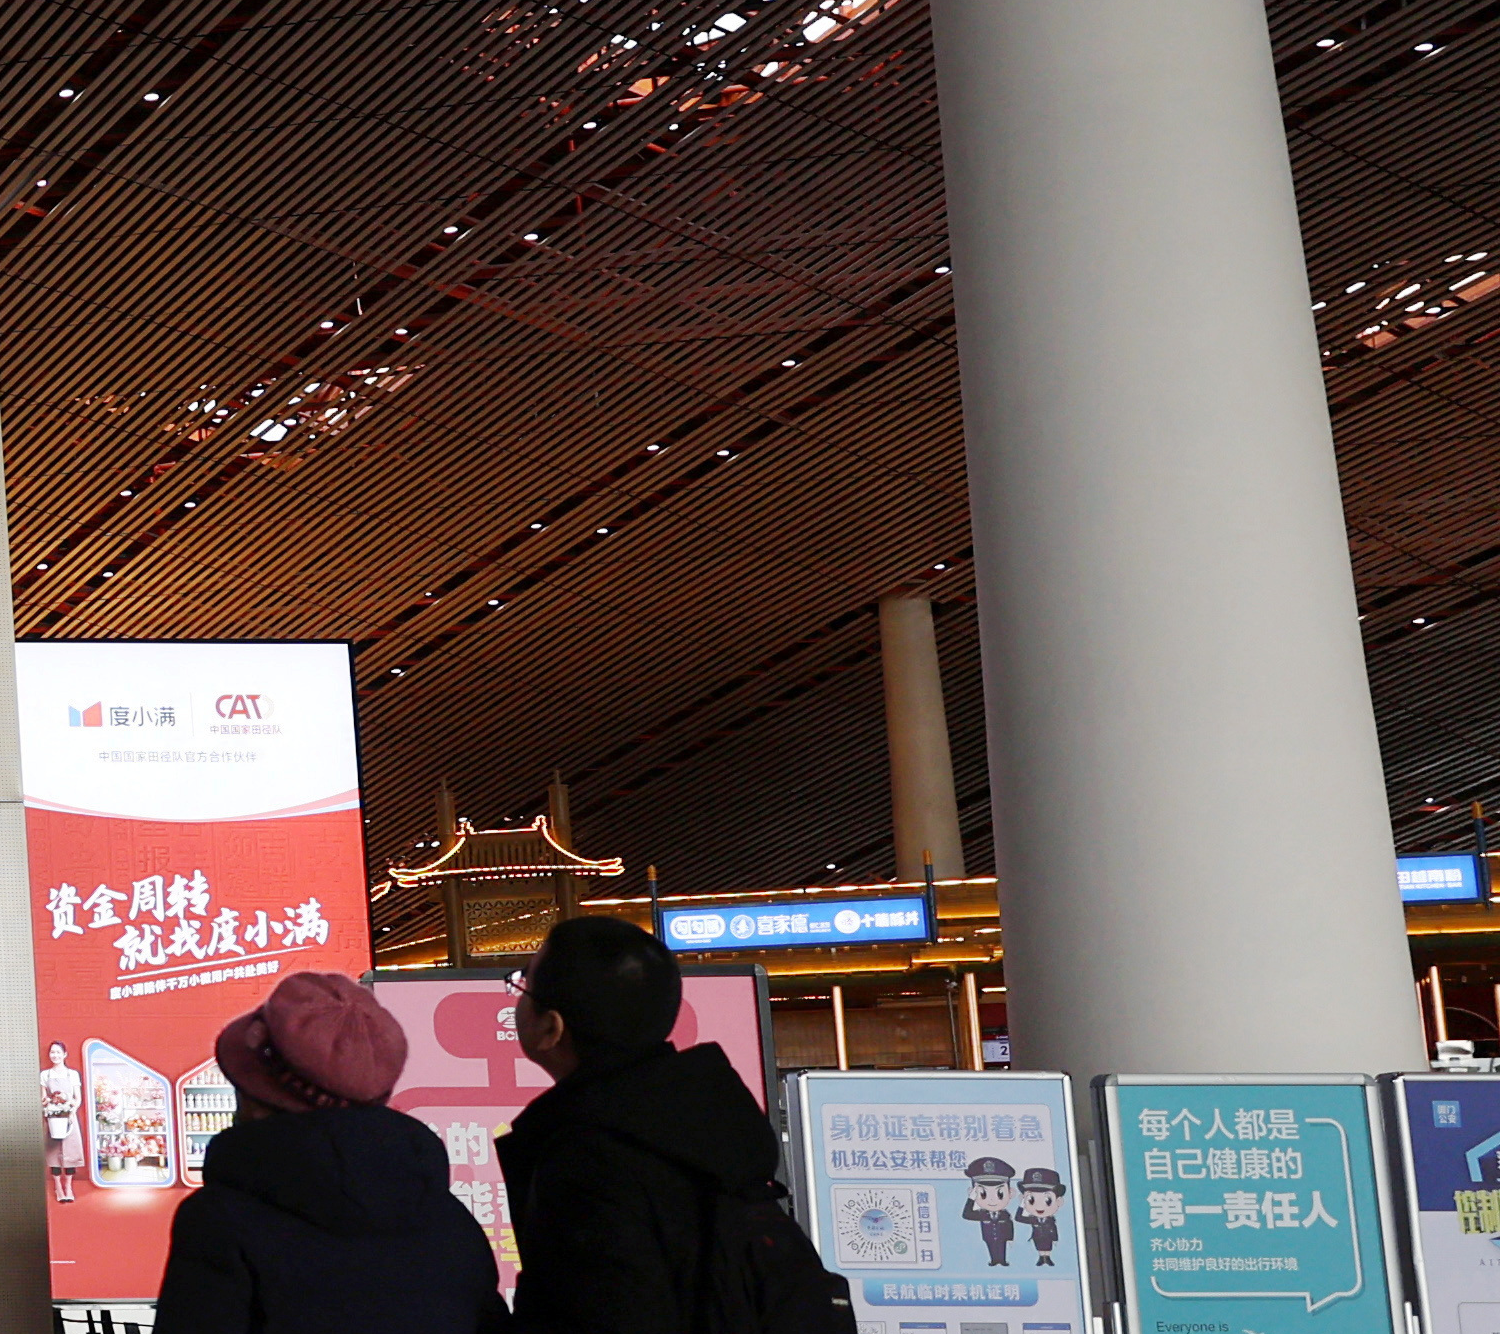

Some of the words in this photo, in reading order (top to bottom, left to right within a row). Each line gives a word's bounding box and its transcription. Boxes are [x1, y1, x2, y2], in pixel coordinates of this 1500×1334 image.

[110, 706, 176, 727] 度小满
[210, 725, 282, 734] 中国国家田径队
[99, 751, 256, 762] 中国国家田径队官方合作伙伴
[46, 869, 210, 939] 资金周转
[830, 1114, 1044, 1141] 身份证忘带别着急
[1139, 1109, 1299, 1141] 每个人都是
[831, 1149, 966, 1170] 机场公安来帮您
[1144, 1148, 1302, 1179] 自己健康的
[1147, 1190, 1338, 1229] 第一责任人
[916, 1192, 934, 1262] 微信扫一扫
[1151, 1238, 1203, 1252] 齐心协力
[1152, 1258, 1298, 1271] 共同维护良好的出行环境
[883, 1283, 1020, 1301] 民航临时乘机证明
[1157, 1321, 1215, 1334] Everyone
[1219, 1322, 1229, 1333] is
